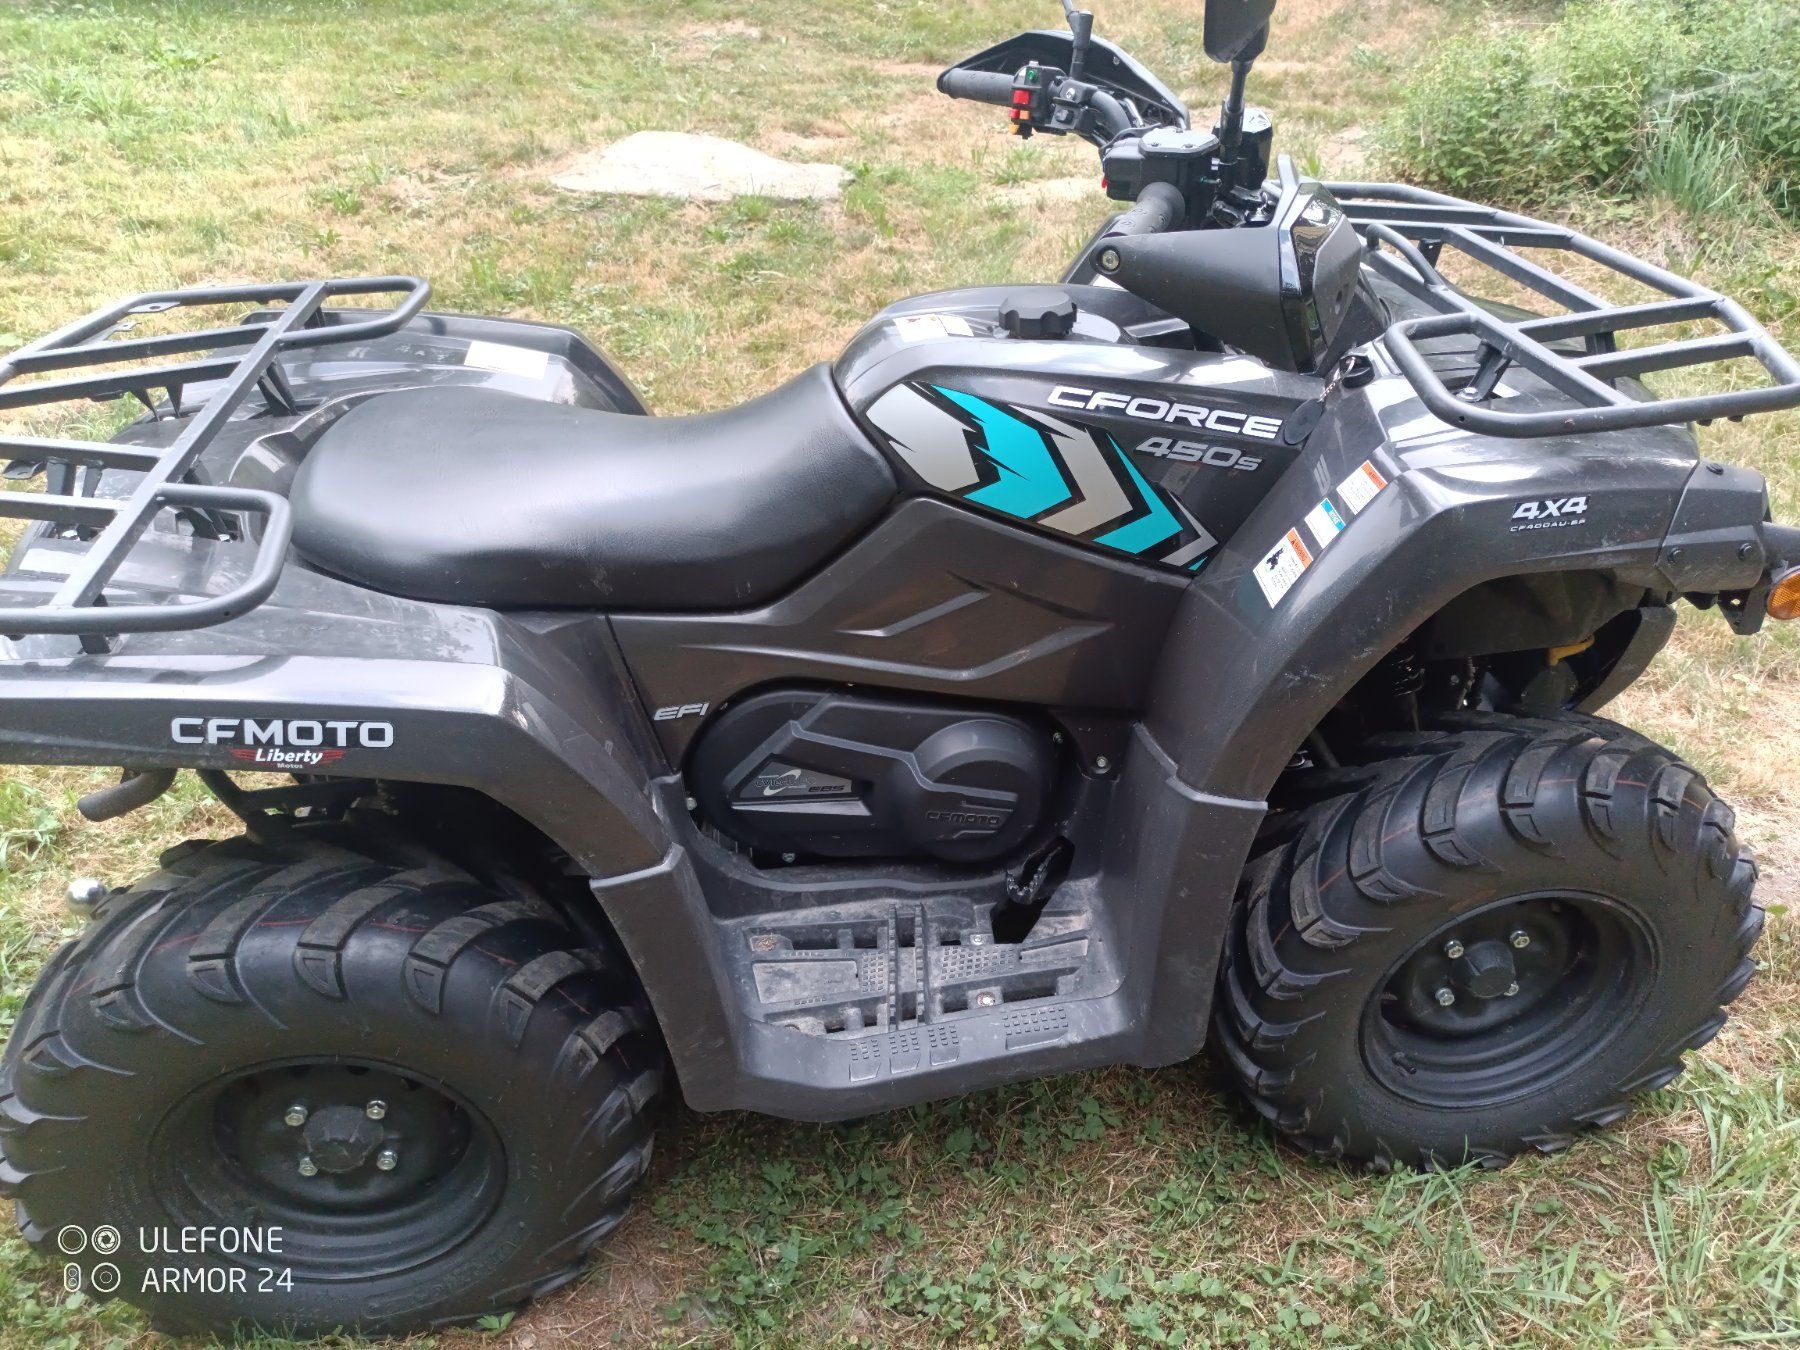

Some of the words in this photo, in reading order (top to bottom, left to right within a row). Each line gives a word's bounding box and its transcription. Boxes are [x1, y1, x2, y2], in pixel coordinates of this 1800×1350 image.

[1047, 385, 1283, 439] CFORCE
[653, 702, 710, 721] EFI
[171, 717, 394, 748] CFMOTO
[255, 748, 323, 765] Liberty
[926, 811, 1000, 828] CFMOTO
